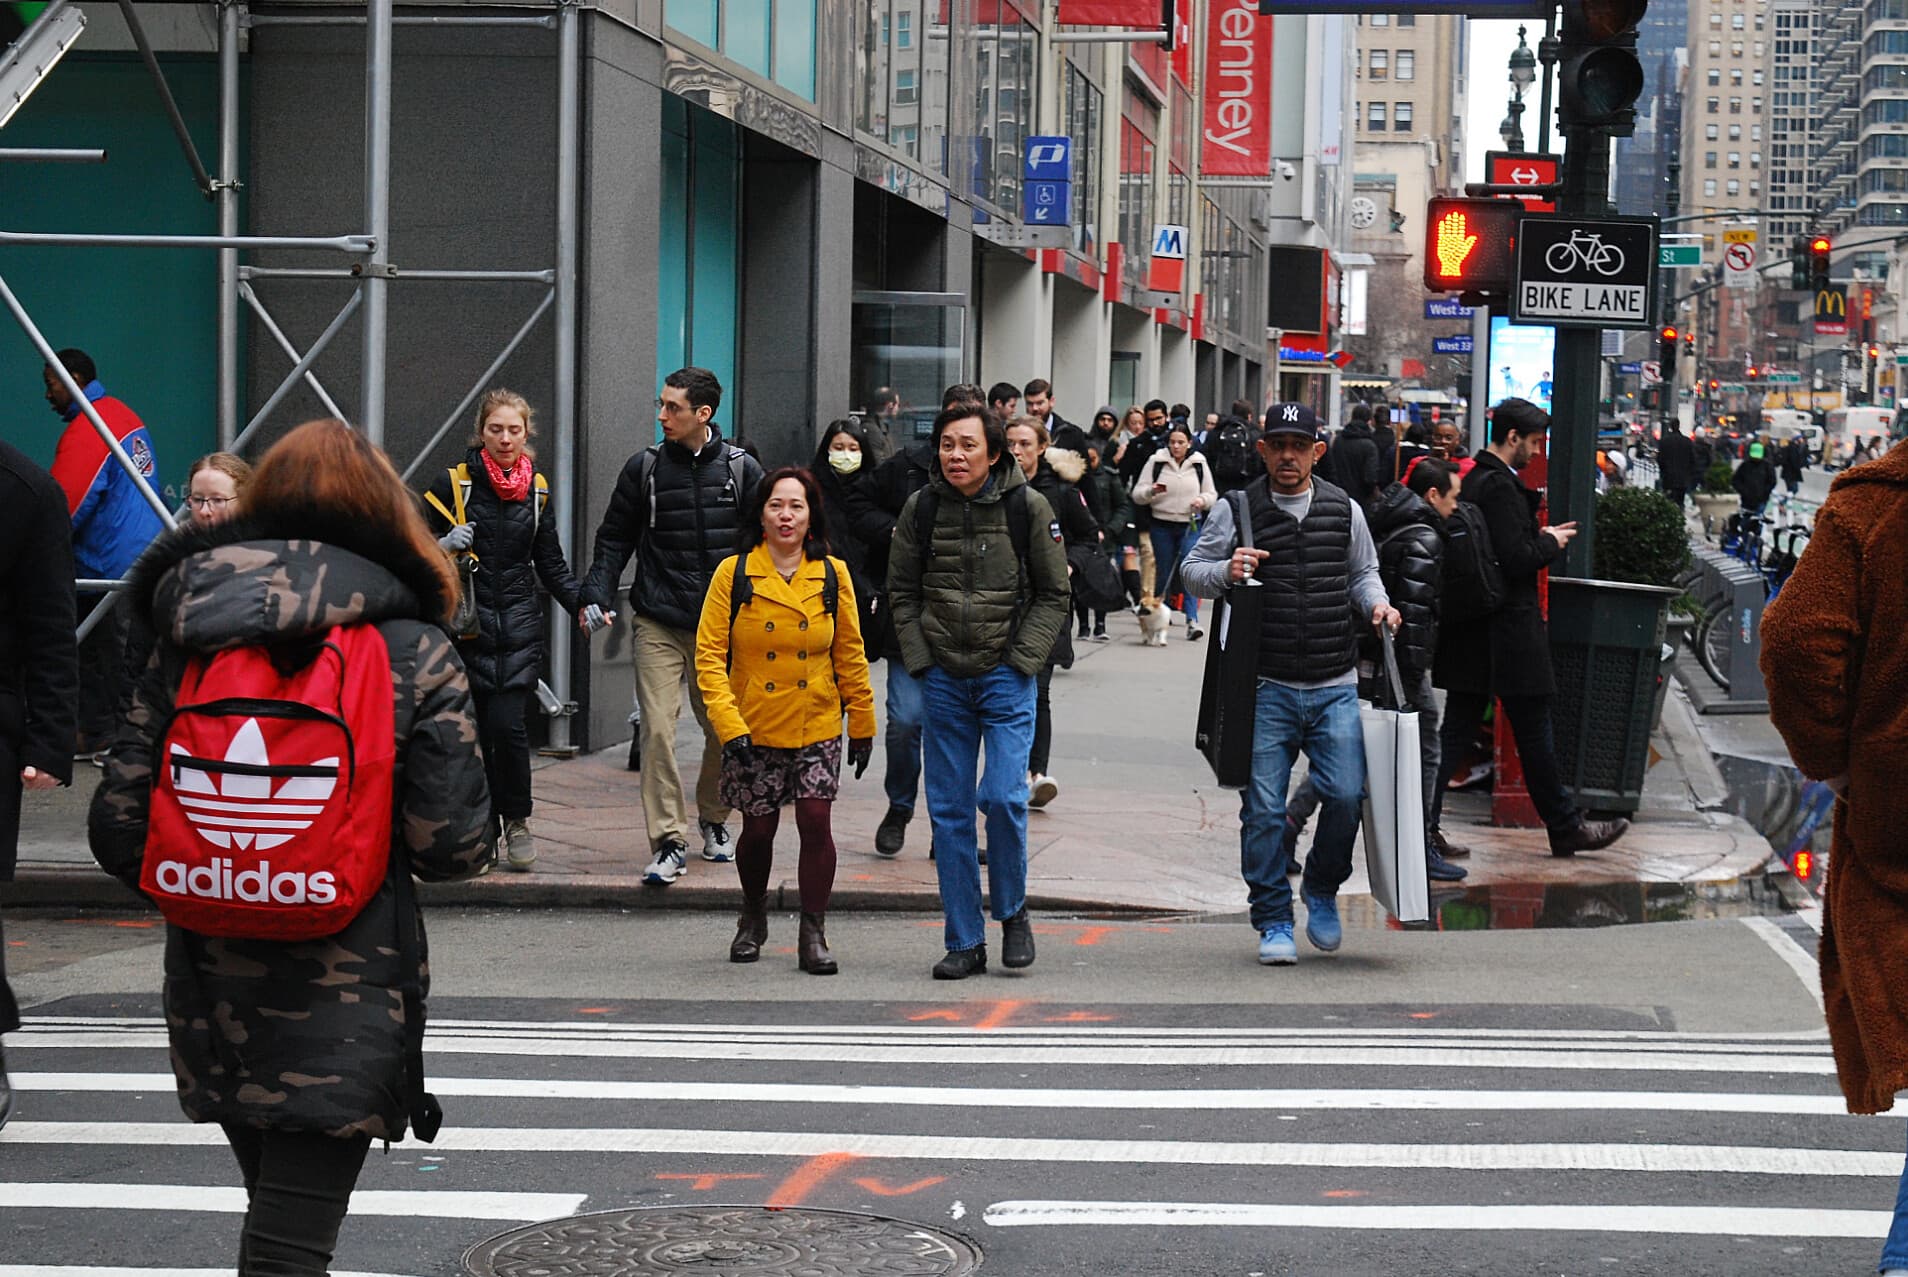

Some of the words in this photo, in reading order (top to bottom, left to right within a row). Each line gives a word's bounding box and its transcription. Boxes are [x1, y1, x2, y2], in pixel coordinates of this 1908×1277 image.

[1662, 249, 1675, 262] St
[1526, 286, 1572, 309] BIKE
[1584, 288, 1640, 312] LANE
[1429, 304, 1457, 315] West
[1437, 341, 1459, 351] West
[156, 857, 337, 903] adidas
